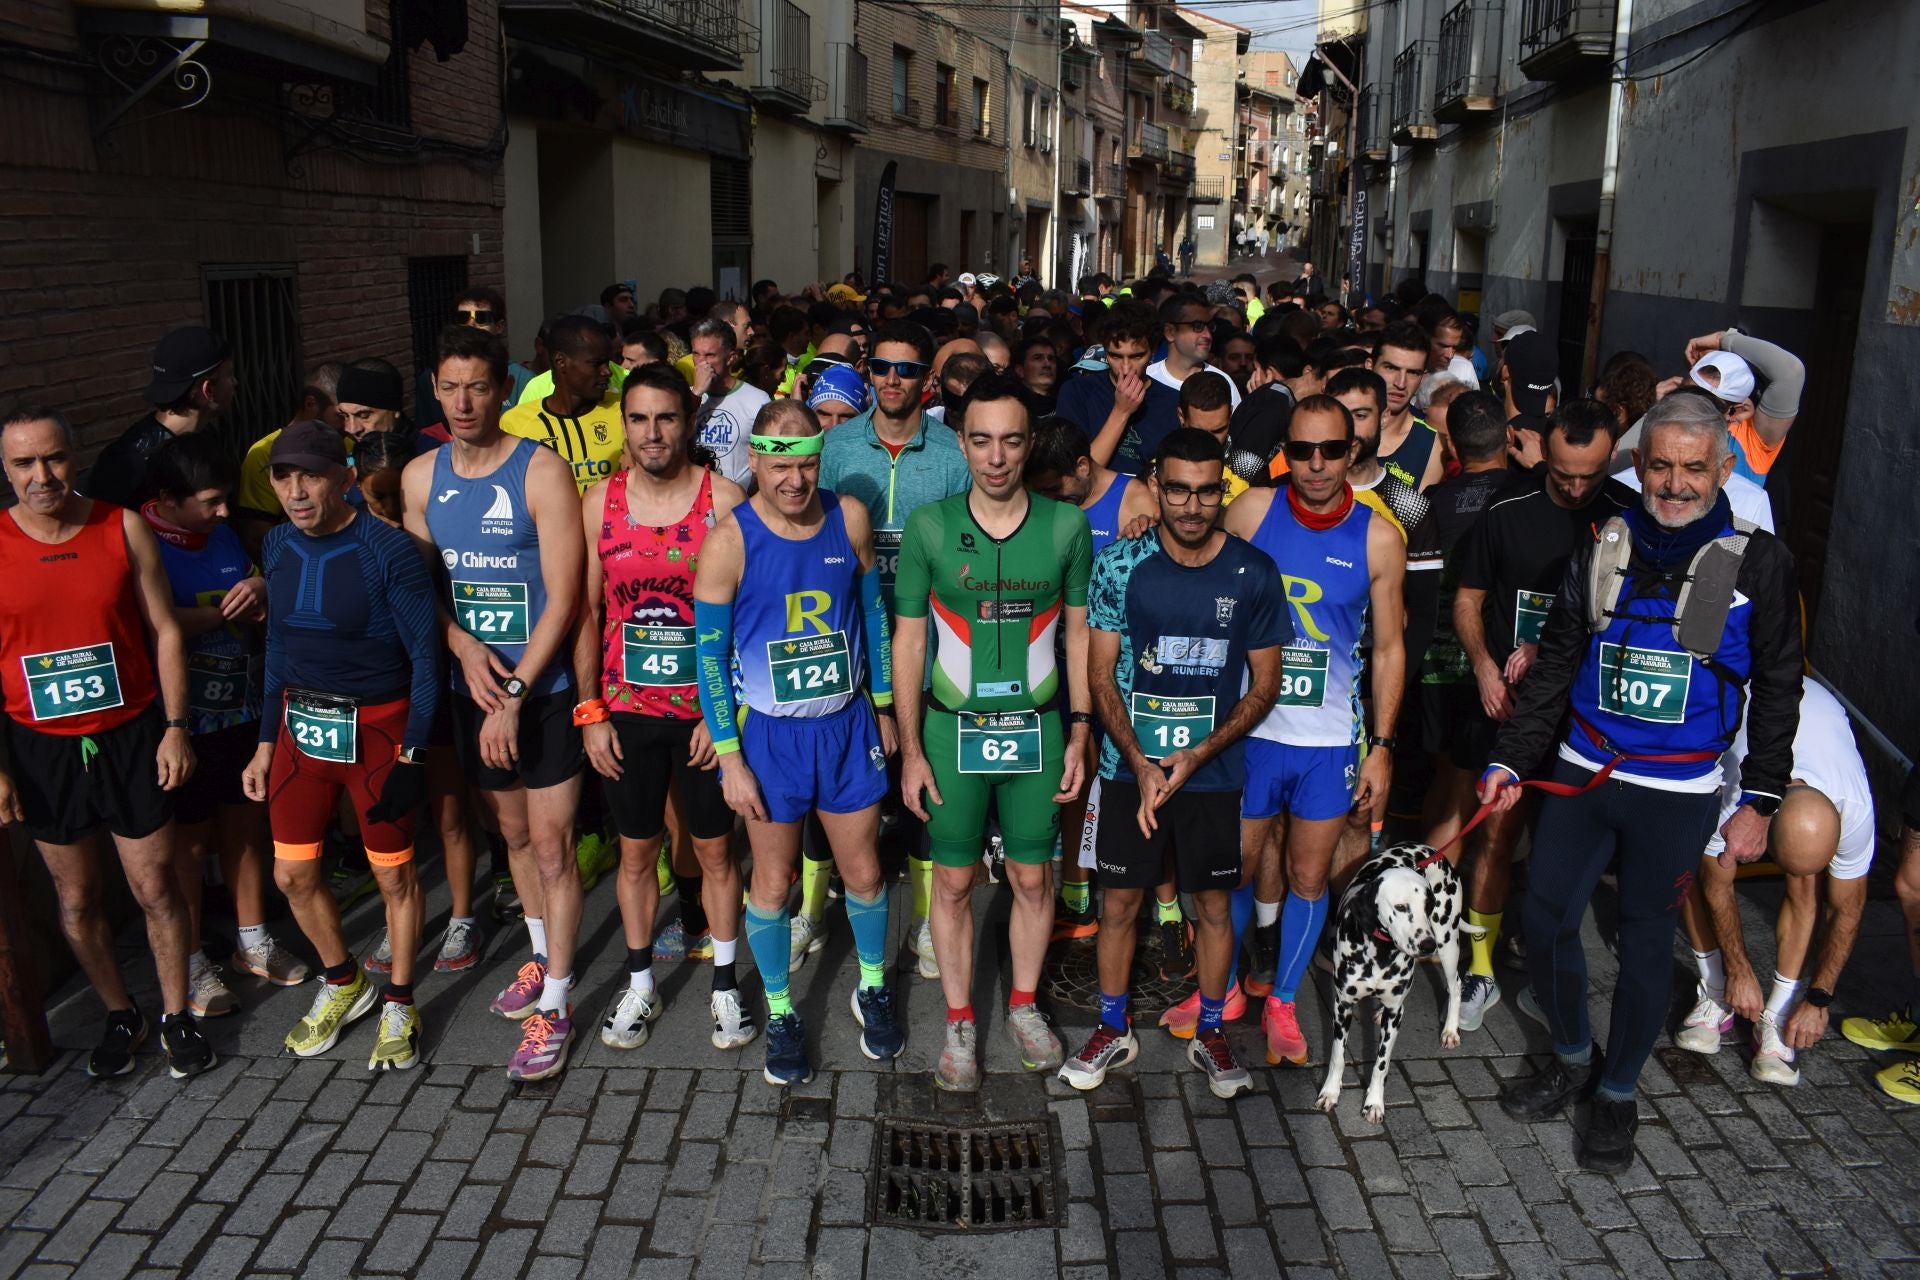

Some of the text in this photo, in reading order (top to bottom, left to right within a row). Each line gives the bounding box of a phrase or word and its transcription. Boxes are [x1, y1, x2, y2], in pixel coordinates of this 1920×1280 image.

[640, 88, 688, 129] CaixaBank
[492, 526, 513, 536] Rioja
[461, 551, 517, 569] Chiruca
[963, 576, 1050, 592] CataNatura
[785, 589, 833, 635] R
[1280, 573, 1331, 642] R
[465, 609, 514, 632] 127
[799, 638, 832, 649] CAJA RURAL
[809, 643, 835, 652] NAVARRA
[55, 650, 94, 662] CAJA RURAL
[67, 655, 98, 665] NAVARRA
[642, 653, 679, 675] 45
[1286, 656, 1313, 664] NAVARRA
[1640, 660, 1672, 669] NAVARRA
[1646, 654, 1670, 663] RURAL
[787, 661, 840, 690] 124
[1172, 665, 1219, 678] RUNNERS
[44, 675, 106, 705] 153
[203, 681, 235, 701] 82
[1280, 675, 1313, 696] 30
[1611, 676, 1672, 708] 207
[713, 699, 731, 729] RIOJA
[295, 721, 338, 750] 231
[1154, 725, 1190, 748] 18
[982, 738, 1019, 761] 62
